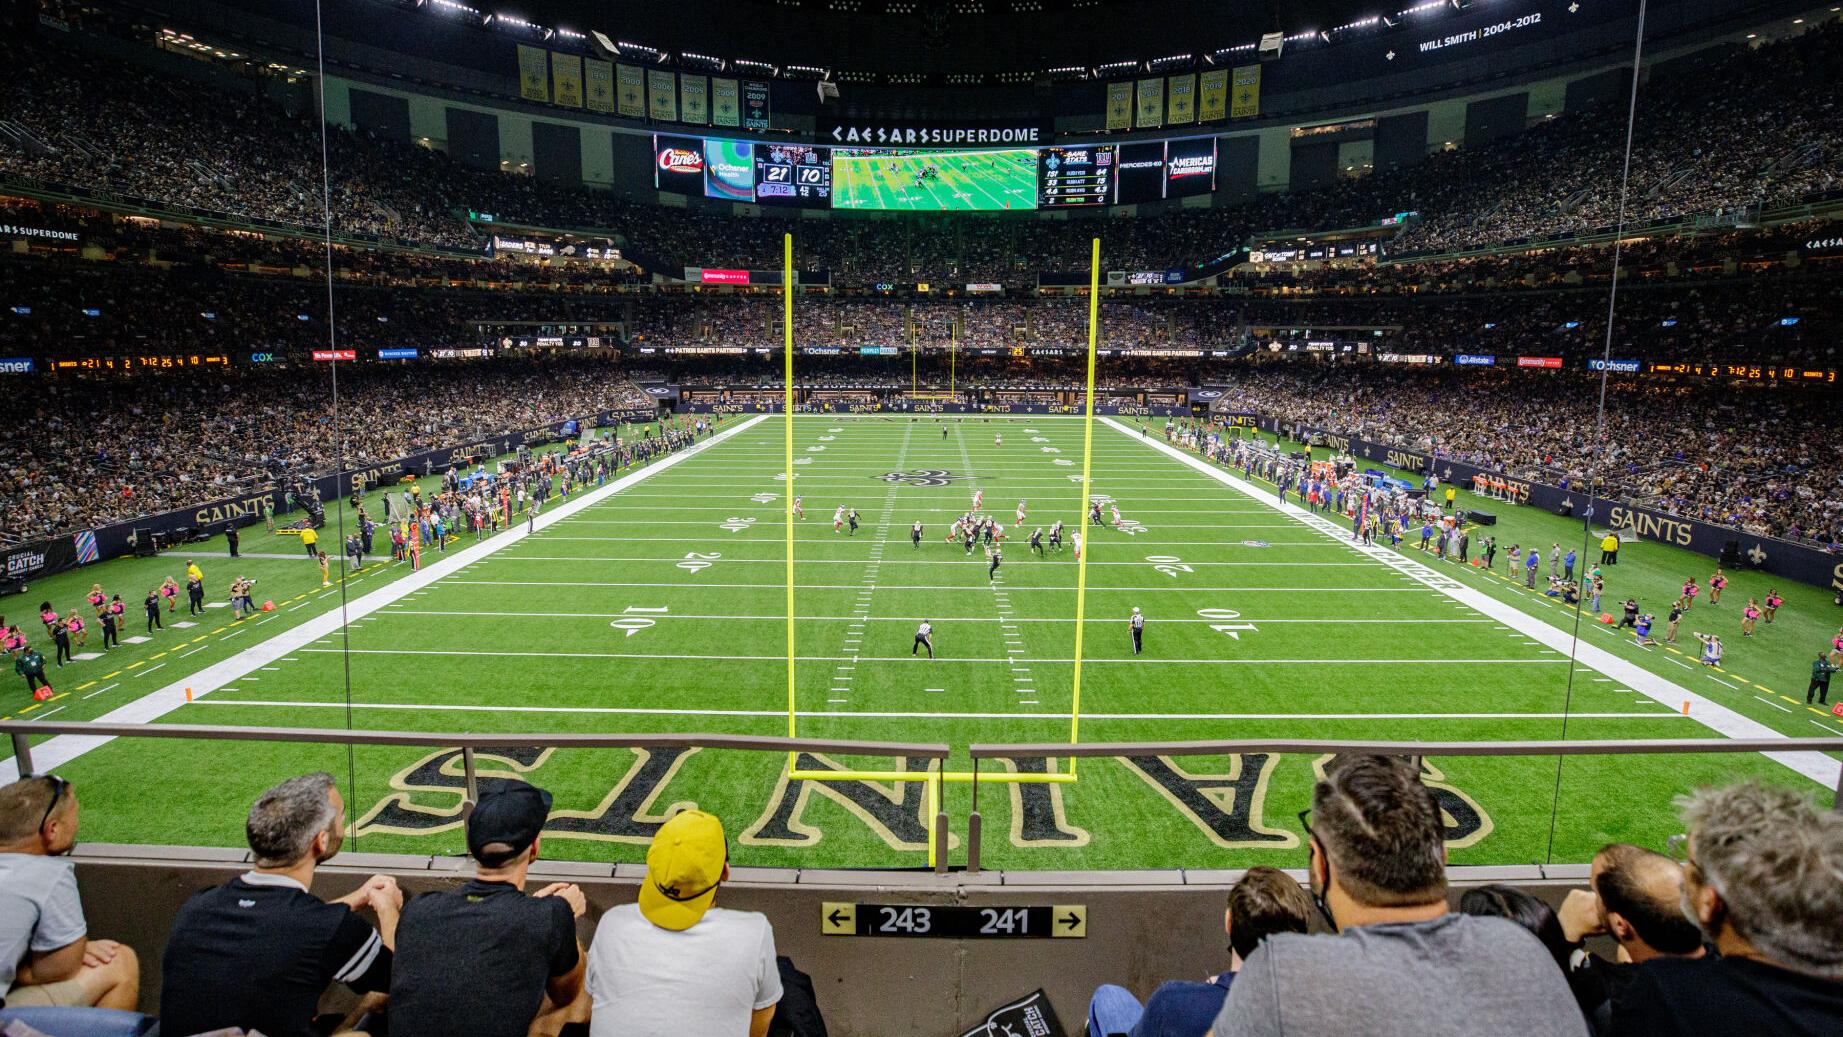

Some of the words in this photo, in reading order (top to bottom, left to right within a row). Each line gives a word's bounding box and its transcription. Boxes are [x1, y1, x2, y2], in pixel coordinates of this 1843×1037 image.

[1420, 42, 1443, 51] WILL
[1444, 31, 1476, 45] SMITH
[1483, 13, 1541, 37] 2004-2012
[832, 126, 929, 143] CAESARS
[932, 128, 1039, 142] SUPERDOME
[660, 148, 702, 169] Cane's
[718, 163, 749, 172] Ochsner
[768, 167, 788, 181] 21
[802, 168, 820, 182] 10
[771, 185, 788, 194] 7:12
[20, 227, 78, 240] SUPERDOME
[88, 359, 100, 368] 21
[125, 360, 131, 368] 2
[140, 357, 157, 366] 7:12
[162, 358, 172, 367] 25
[178, 358, 183, 366] 4
[191, 356, 198, 364] 10
[222, 356, 228, 364] 3
[251, 353, 273, 362] COX
[1468, 356, 1489, 364] Allstate
[1519, 357, 1545, 366] Community
[1596, 360, 1638, 372] Ochsner
[1712, 368, 1717, 376] 2
[1729, 367, 1745, 375] 7:12
[1749, 369, 1760, 377] 25
[1769, 370, 1775, 378] 4
[1784, 369, 1793, 377] 10
[1828, 373, 1834, 382] 3
[981, 404, 1011, 413] SINTS
[1118, 407, 1148, 415] SAINTS
[579, 415, 597, 430] AINTS
[1327, 435, 1349, 451] AINTS
[1387, 450, 1424, 470] SAINTS
[196, 493, 275, 524] SAINTS
[720, 517, 756, 530] 30
[1610, 506, 1692, 546] SAINTS
[7, 553, 44, 572] CATCH
[676, 552, 722, 569] 20
[1145, 555, 1194, 573] 20
[610, 606, 669, 629] 10
[1197, 608, 1259, 631] 10
[880, 907, 931, 933] 243
[980, 908, 1028, 934] 241
[1023, 1006, 1045, 1036] CATCH
